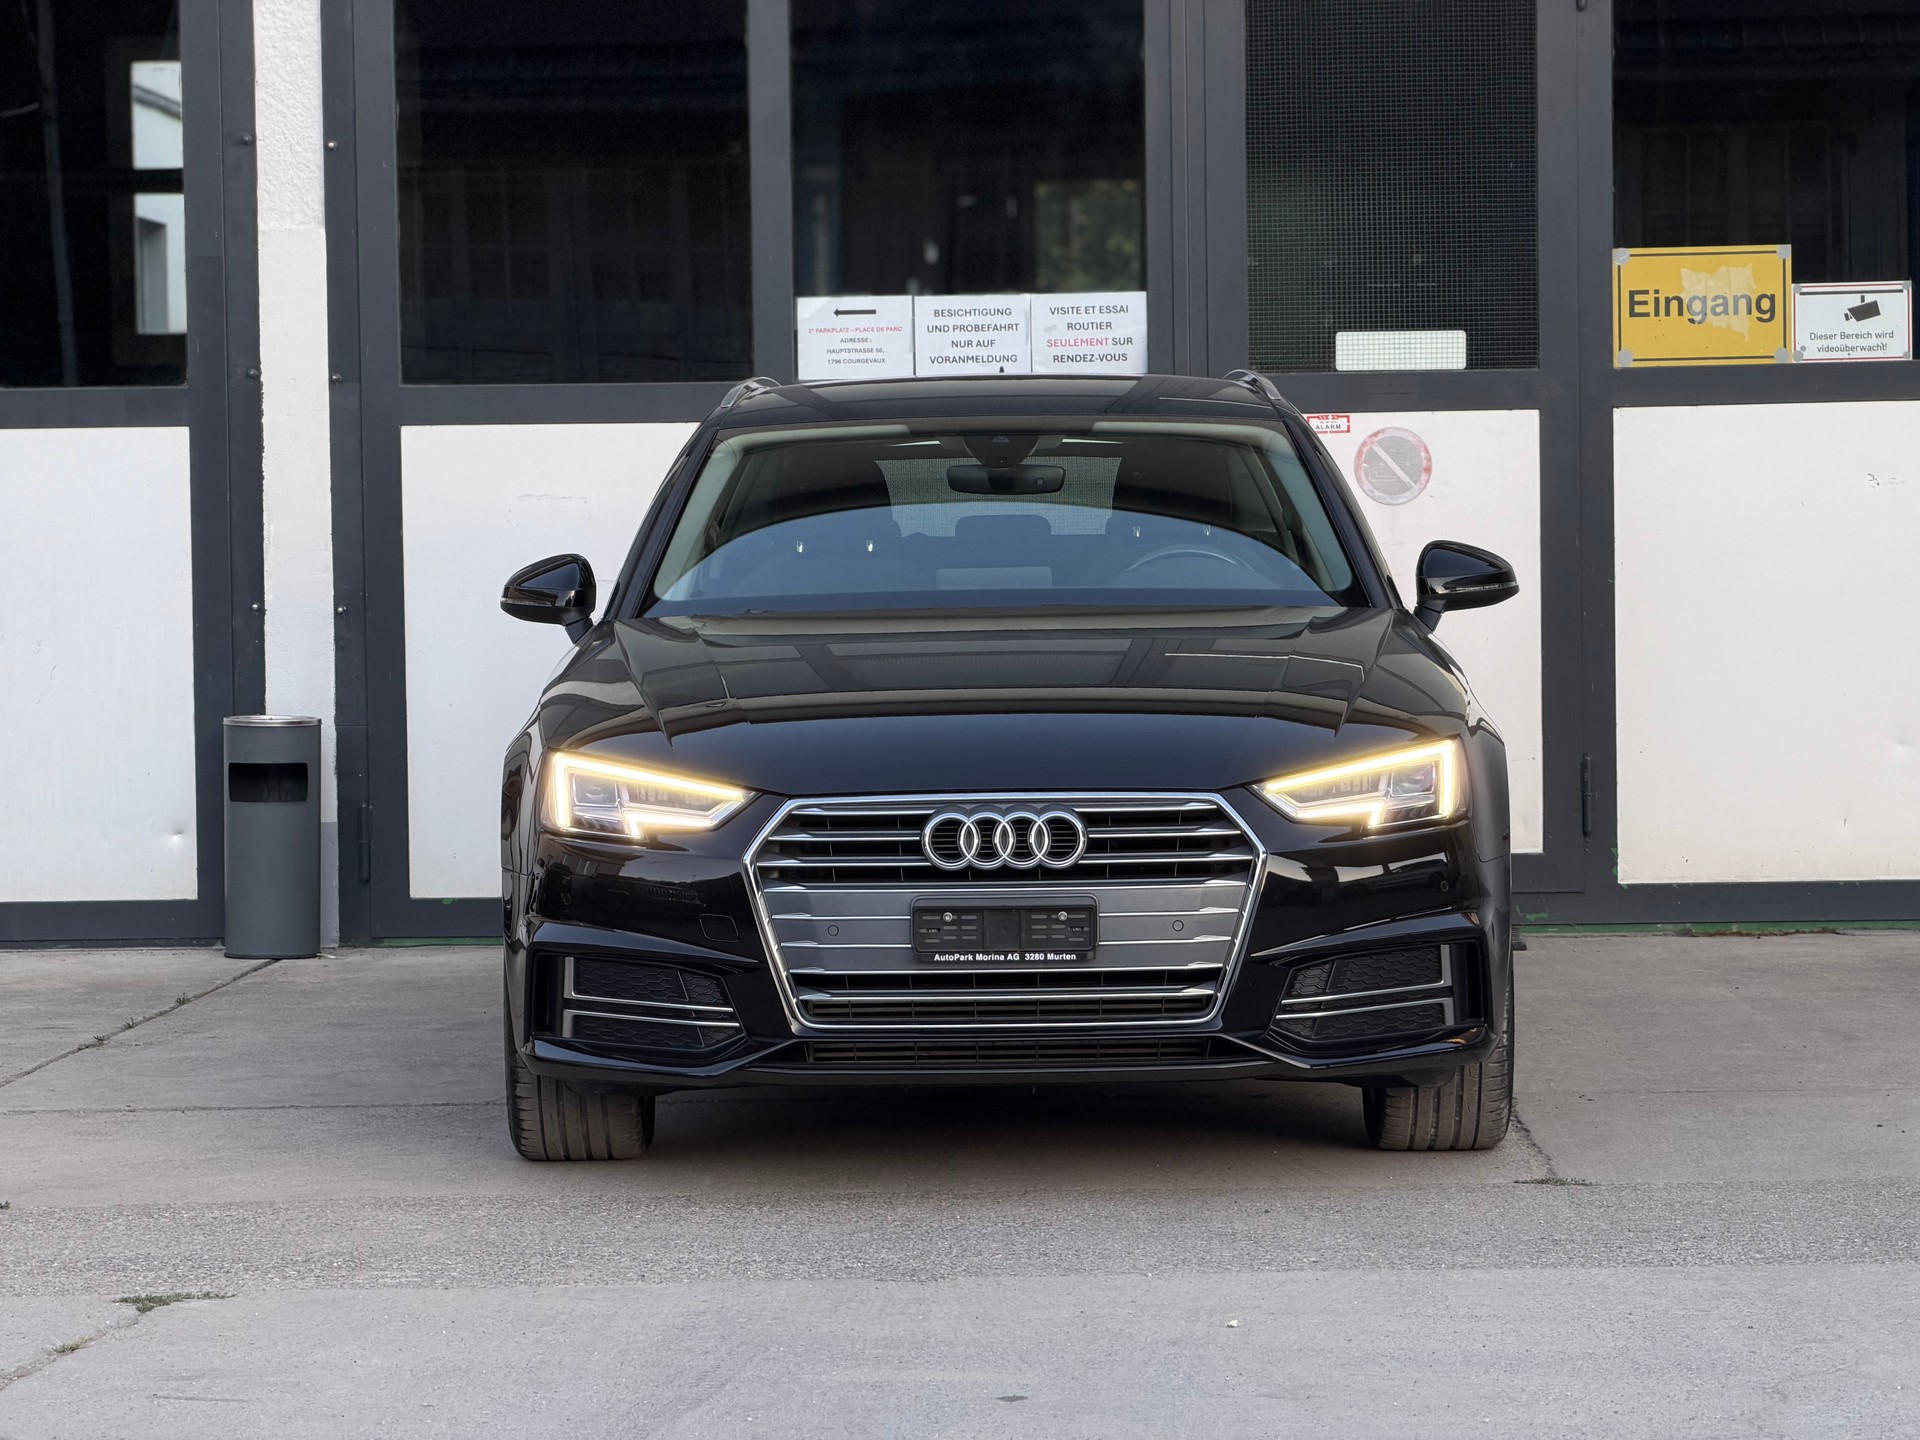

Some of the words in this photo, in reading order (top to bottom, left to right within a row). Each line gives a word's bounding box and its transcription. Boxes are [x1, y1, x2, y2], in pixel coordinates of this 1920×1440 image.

[1049, 306, 1082, 315] VISITE
[1084, 305, 1096, 315] ET
[1098, 305, 1129, 314] ESSAI
[1628, 288, 1776, 325] Eingang
[933, 307, 1013, 318] BESICHTIGUNG
[926, 324, 950, 334] UND
[952, 323, 1020, 333] PROBEFAHRT
[1066, 321, 1113, 331] ROUTIER
[1809, 331, 1838, 341] Dieser
[1840, 330, 1873, 340] Bereich
[1874, 330, 1894, 339] wird
[951, 339, 974, 349] NUR
[975, 339, 996, 348] AUF
[1046, 337, 1110, 348] SEULEMENT
[1111, 337, 1134, 346] SUR
[1816, 342, 1888, 353] videoüberwacht!
[929, 354, 1018, 364] VORANMELDUNG
[1052, 353, 1128, 363] RENDEZ-VOUS
[934, 953, 974, 961] AutoPark
[975, 953, 1005, 961] Morina
[1047, 952, 1077, 960] Murten
